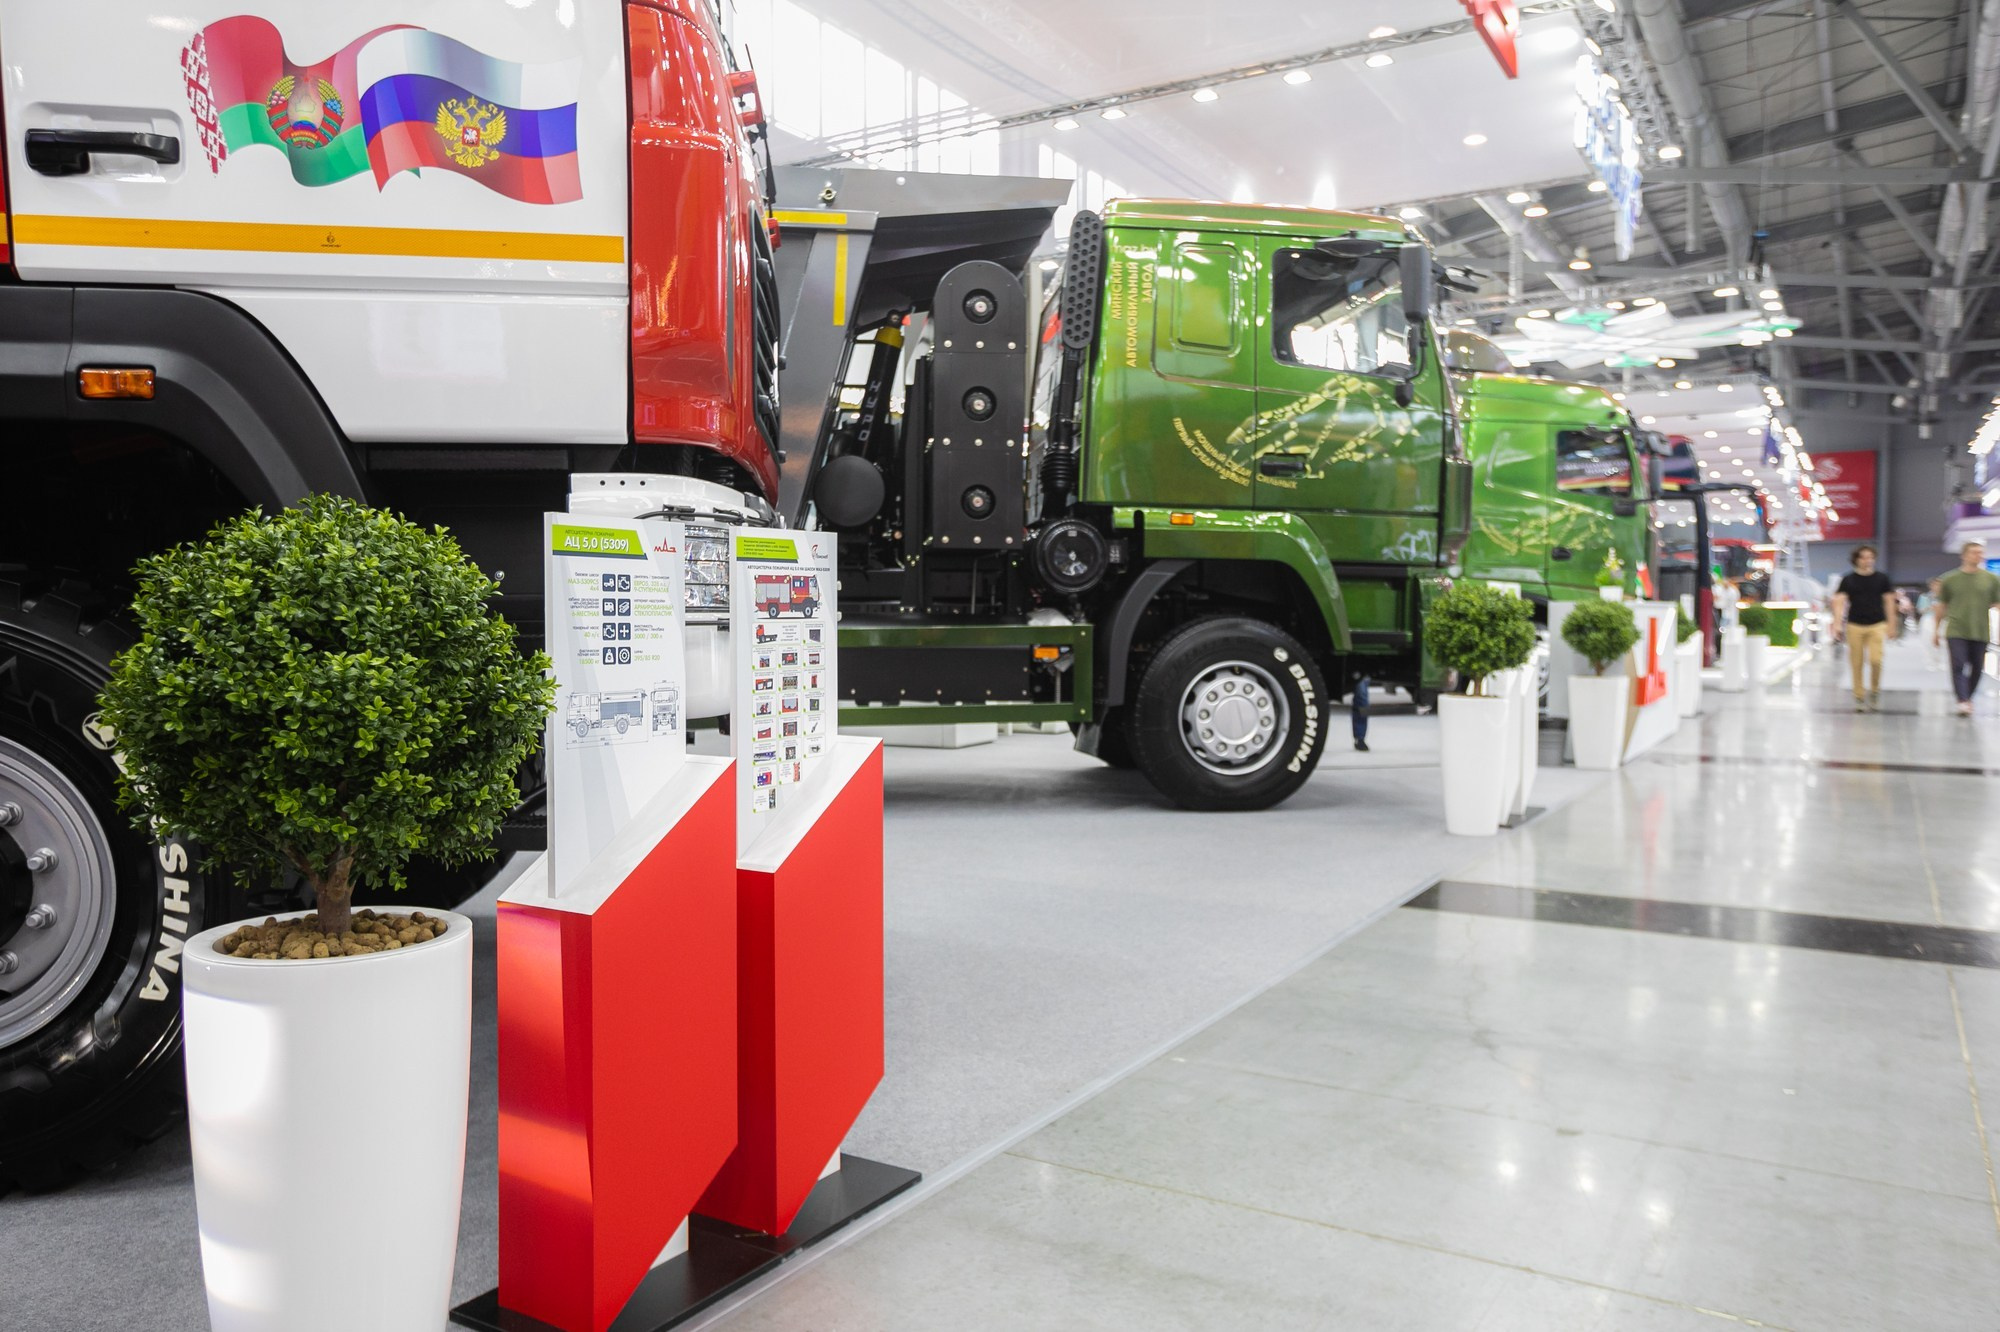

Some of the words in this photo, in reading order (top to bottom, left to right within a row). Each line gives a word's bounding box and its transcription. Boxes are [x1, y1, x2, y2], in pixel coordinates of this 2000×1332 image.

[1111, 261, 1123, 320] МИНСКИЙ
[1141, 263, 1155, 304] ЗАВОД
[1126, 261, 1139, 368] АВТОМОБИЛЬНЫЙ
[1173, 417, 1195, 448] ПЕРВЫЙ
[1191, 446, 1217, 468] СРЕДИ
[1194, 429, 1227, 462] МОЩНЫЙ
[564, 536, 580, 550] АЦ
[582, 537, 598, 551] 5,0
[600, 538, 629, 553] (5309)
[1287, 663, 1319, 773] BELSHINA
